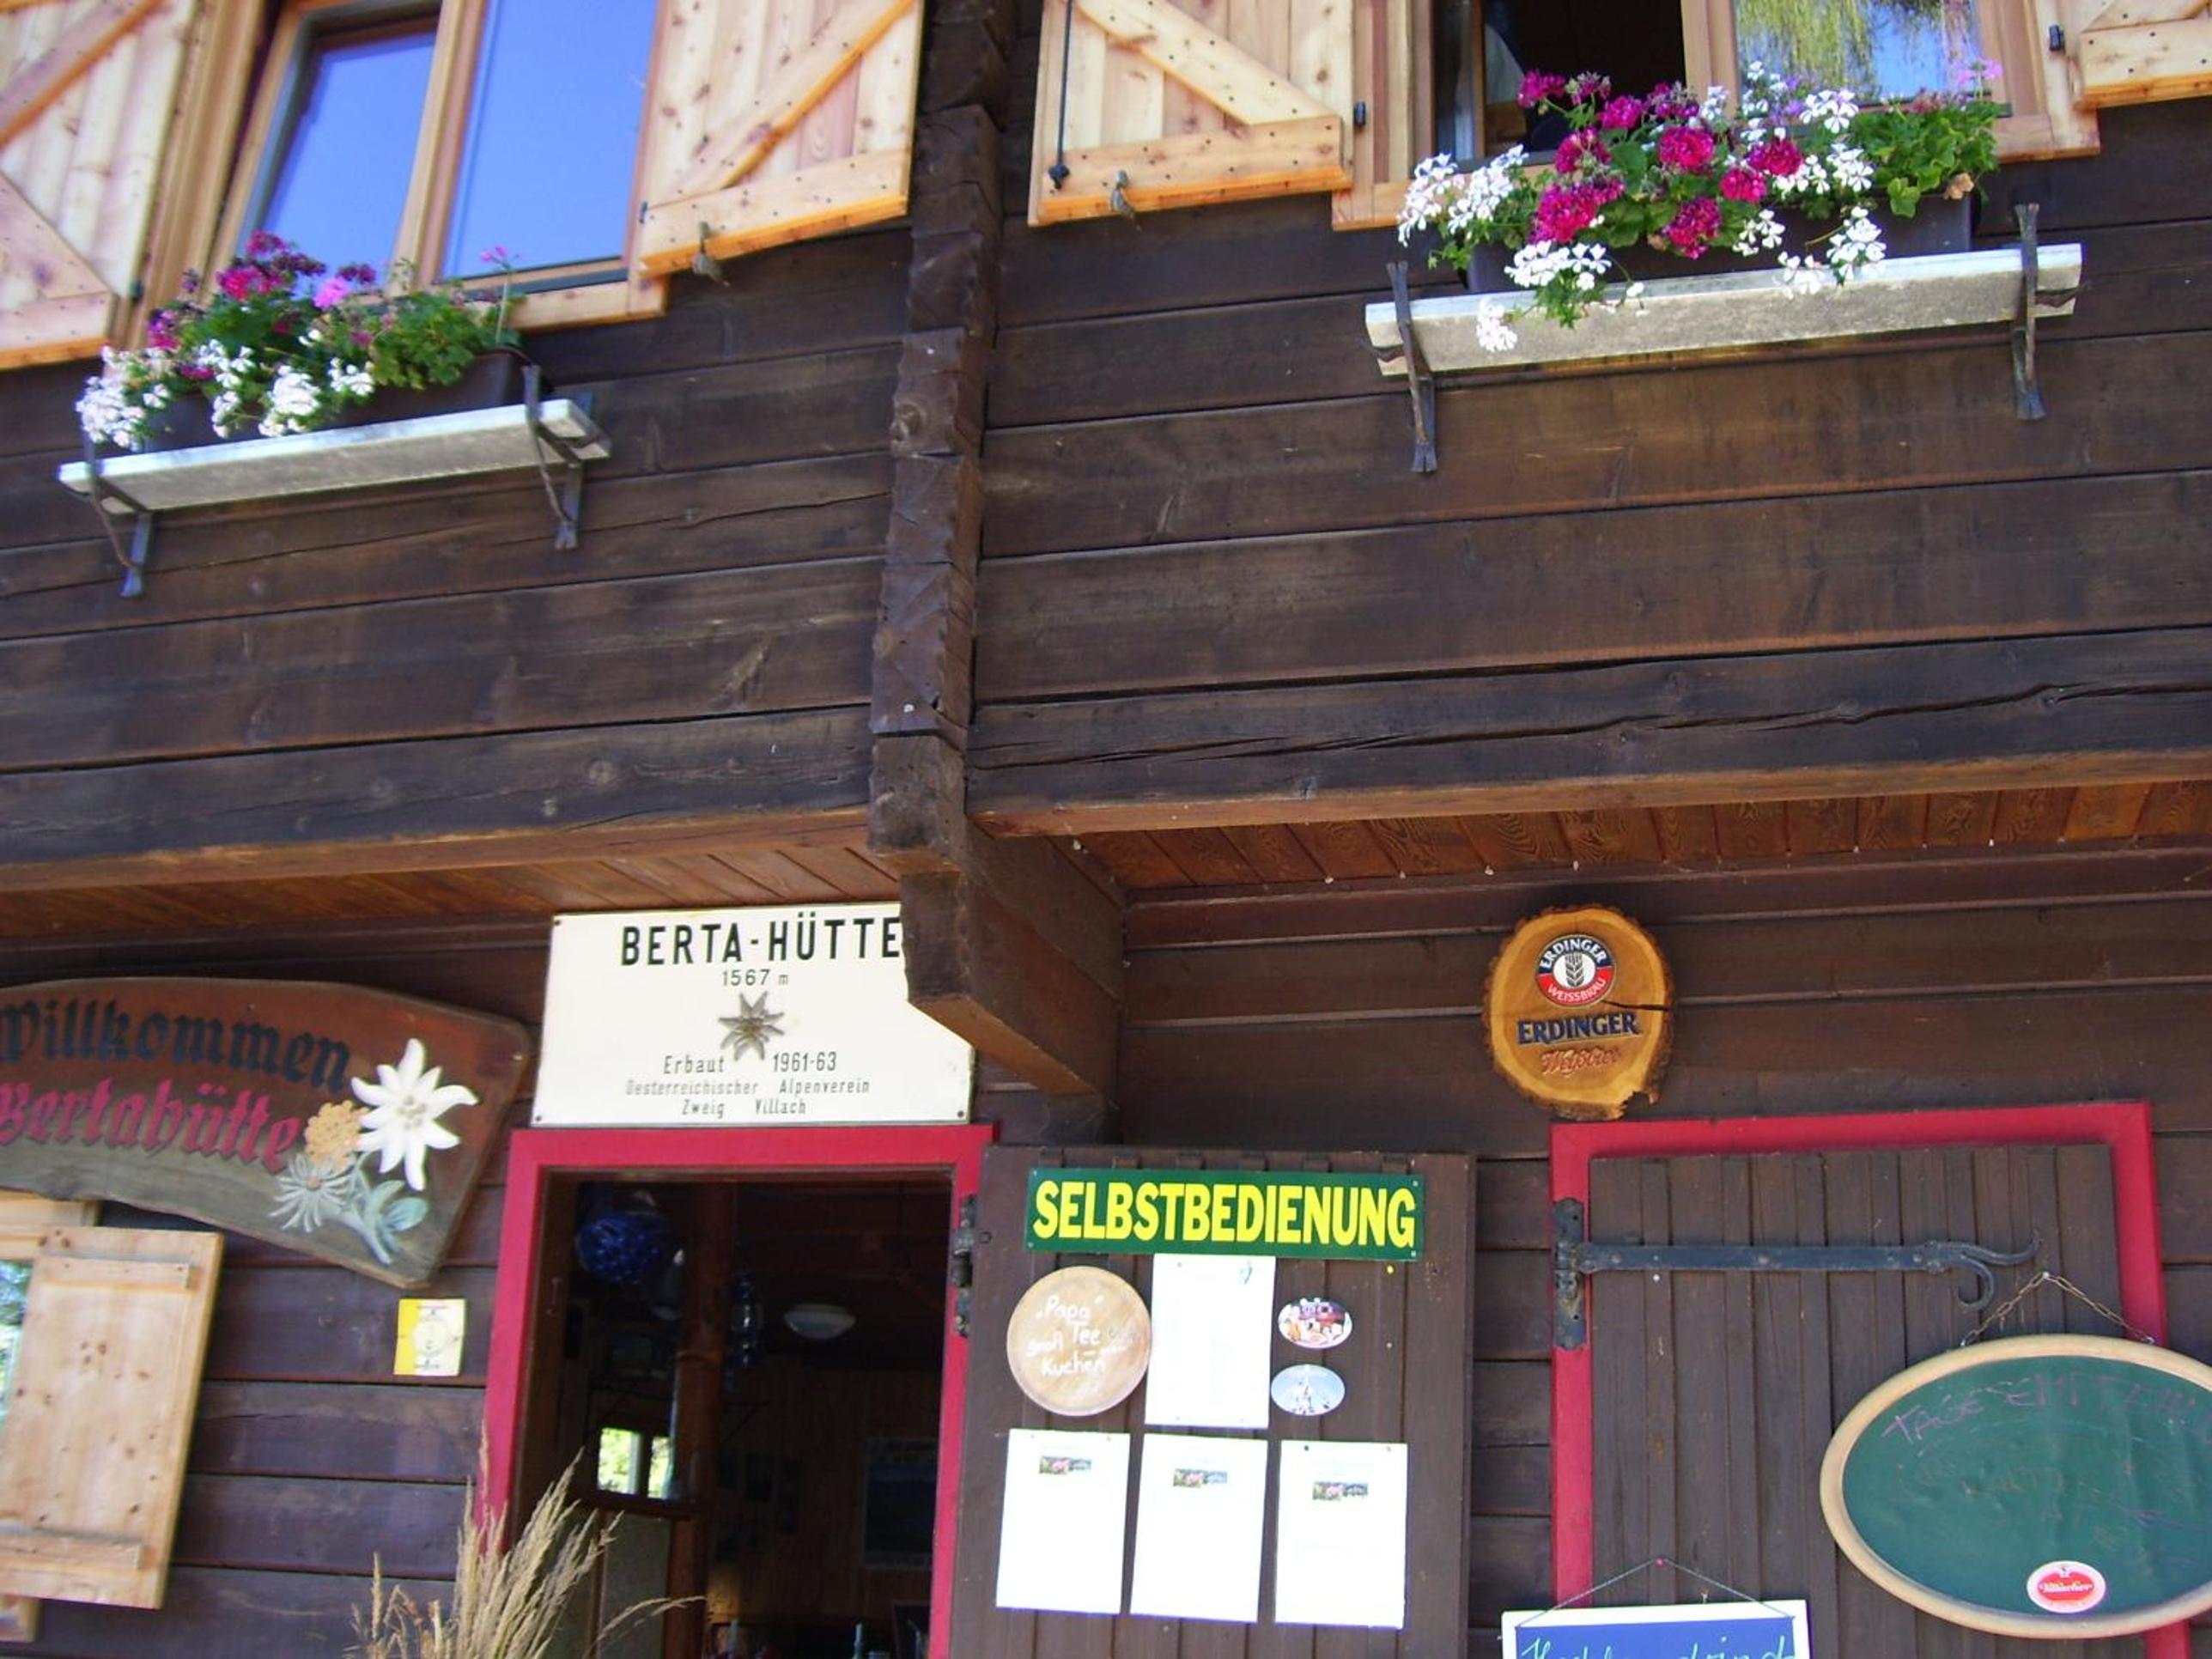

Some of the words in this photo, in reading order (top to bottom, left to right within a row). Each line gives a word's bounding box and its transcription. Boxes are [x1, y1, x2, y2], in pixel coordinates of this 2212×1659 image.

[620, 912, 902, 966] BERTA-HÜTTE
[1540, 938, 1607, 969] ERDINGER
[722, 969, 769, 987] 1567
[778, 972, 789, 986] m
[1517, 1012, 1642, 1045] ERDINGER
[664, 1054, 725, 1075] Erbaut
[773, 1052, 838, 1072] 1961-63
[779, 1078, 871, 1095] Alpenverein
[682, 1098, 726, 1119] Zweig
[755, 1098, 807, 1115] Villach
[1033, 1180, 1417, 1248] SELBSTBEDIENUNG
[1041, 1351, 1107, 1376] Kuchen
